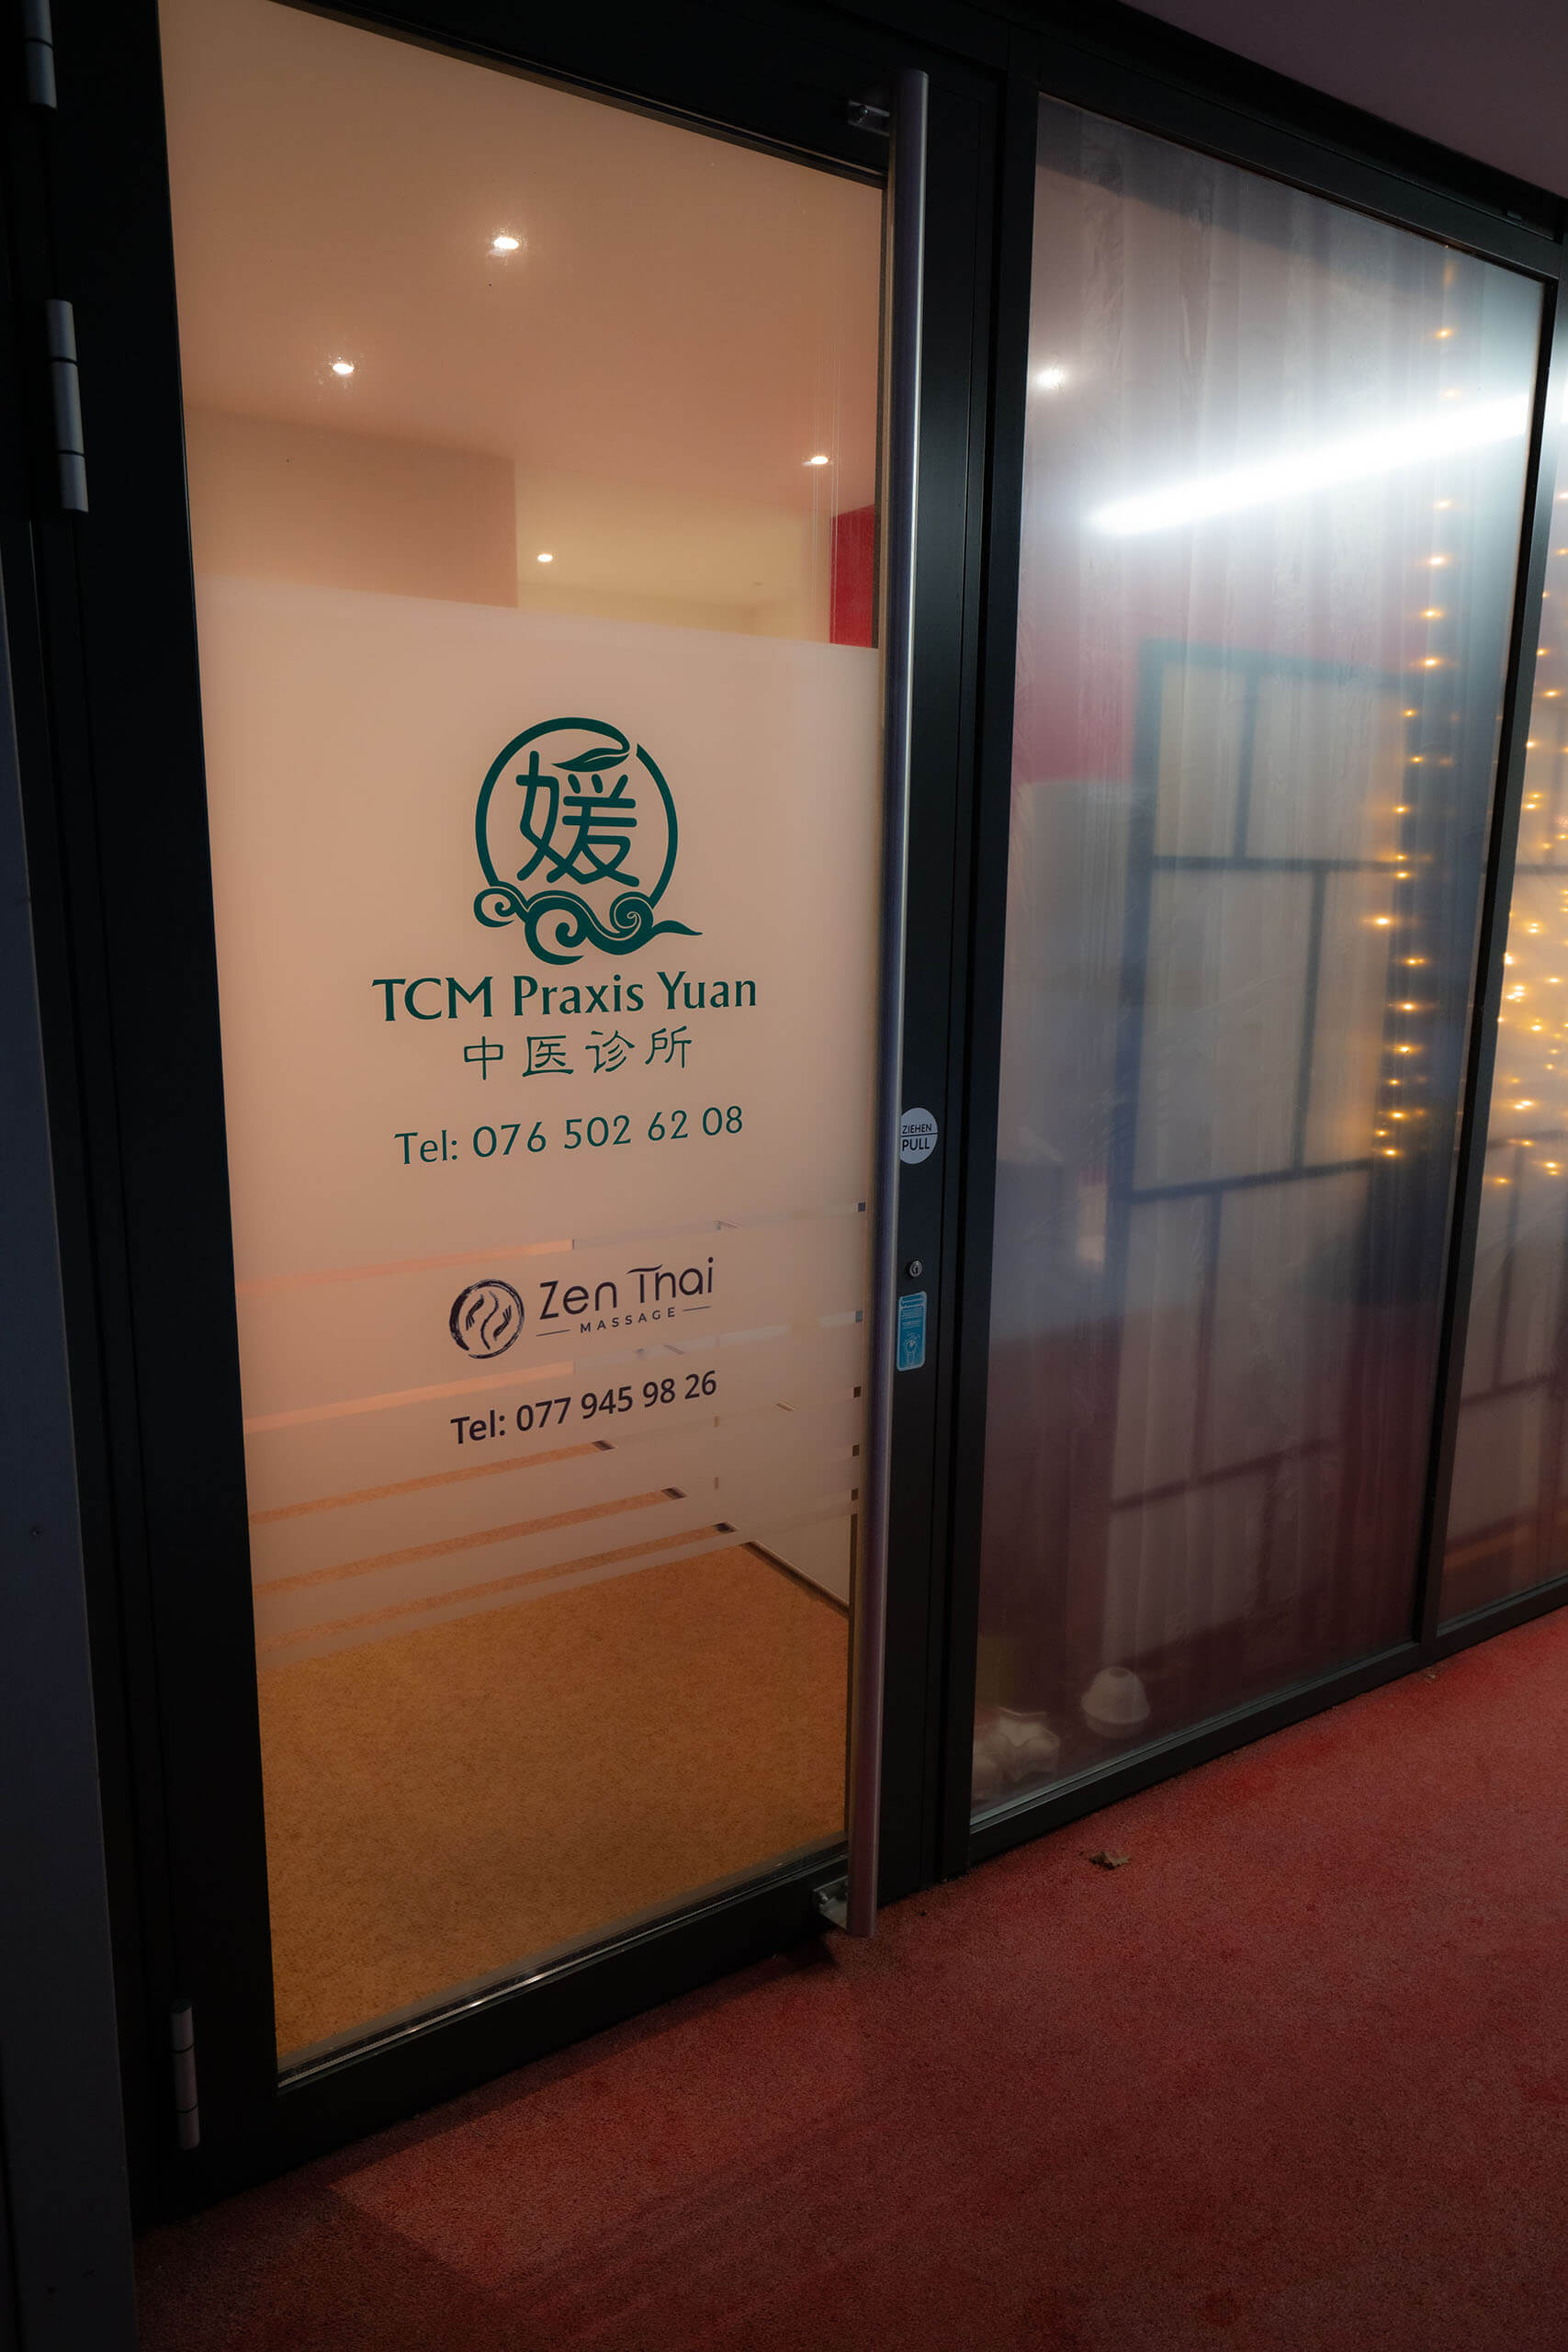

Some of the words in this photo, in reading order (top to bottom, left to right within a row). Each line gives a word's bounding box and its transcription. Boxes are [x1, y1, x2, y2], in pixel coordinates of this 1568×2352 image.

[514, 750, 640, 888] 媛
[371, 976, 494, 1022] TCM
[513, 974, 644, 1016] Praxis
[656, 970, 757, 1010] Yuan
[463, 1025, 693, 1080] 中医诊所
[394, 1130, 458, 1165] Tel:
[472, 1121, 547, 1159] 076
[563, 1114, 632, 1149] 502
[647, 1109, 689, 1142] 62
[702, 1105, 743, 1136] 08
[902, 1124, 932, 1135] ZIEHEN
[902, 1137, 931, 1152] PULL
[539, 1280, 618, 1320] Zen
[579, 1306, 676, 1334] MASSAGE
[449, 1409, 506, 1445] Tel:
[515, 1396, 571, 1432] 077
[581, 1385, 634, 1420] 945
[642, 1377, 676, 1408] 98
[683, 1369, 717, 1399] 26
